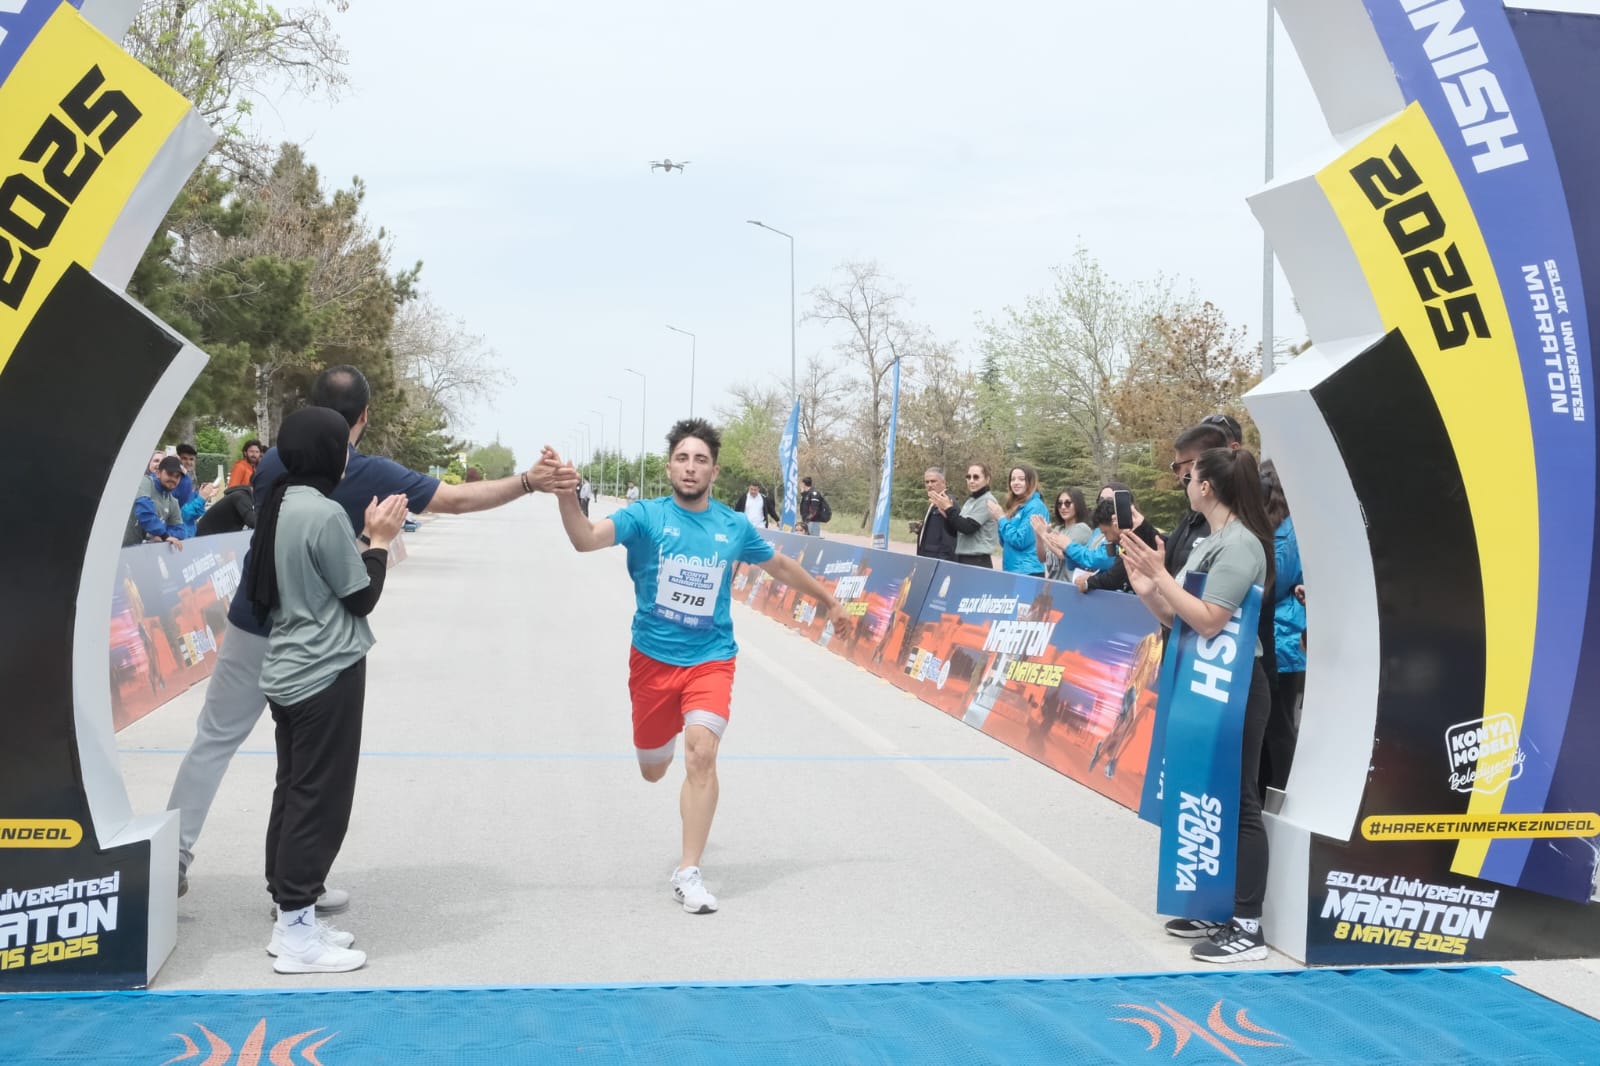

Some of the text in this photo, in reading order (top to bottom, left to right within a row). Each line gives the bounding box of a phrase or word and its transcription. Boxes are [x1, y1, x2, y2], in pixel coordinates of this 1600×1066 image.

[1399, 0, 1529, 173] NISH
[1349, 143, 1492, 351] 2025
[1521, 264, 1569, 413] MARATON
[1560, 320, 1584, 421] UNIVERSITESI
[671, 592, 705, 606] 5718
[982, 619, 1056, 656] MARATON
[1190, 607, 1242, 704] SH
[1452, 720, 1512, 752] KONYA
[1, 828, 72, 840] NDEOL
[1176, 791, 1206, 891] KONYA
[1192, 793, 1222, 876] SPOR
[1369, 819, 1595, 835] #HAREKETINMERKEZINDEOL
[1325, 870, 1389, 893] SELÇUK
[1320, 888, 1492, 940] MARATON
[30, 935, 99, 966] 2025
[1334, 921, 1469, 956] 8 MAYIS 2025
